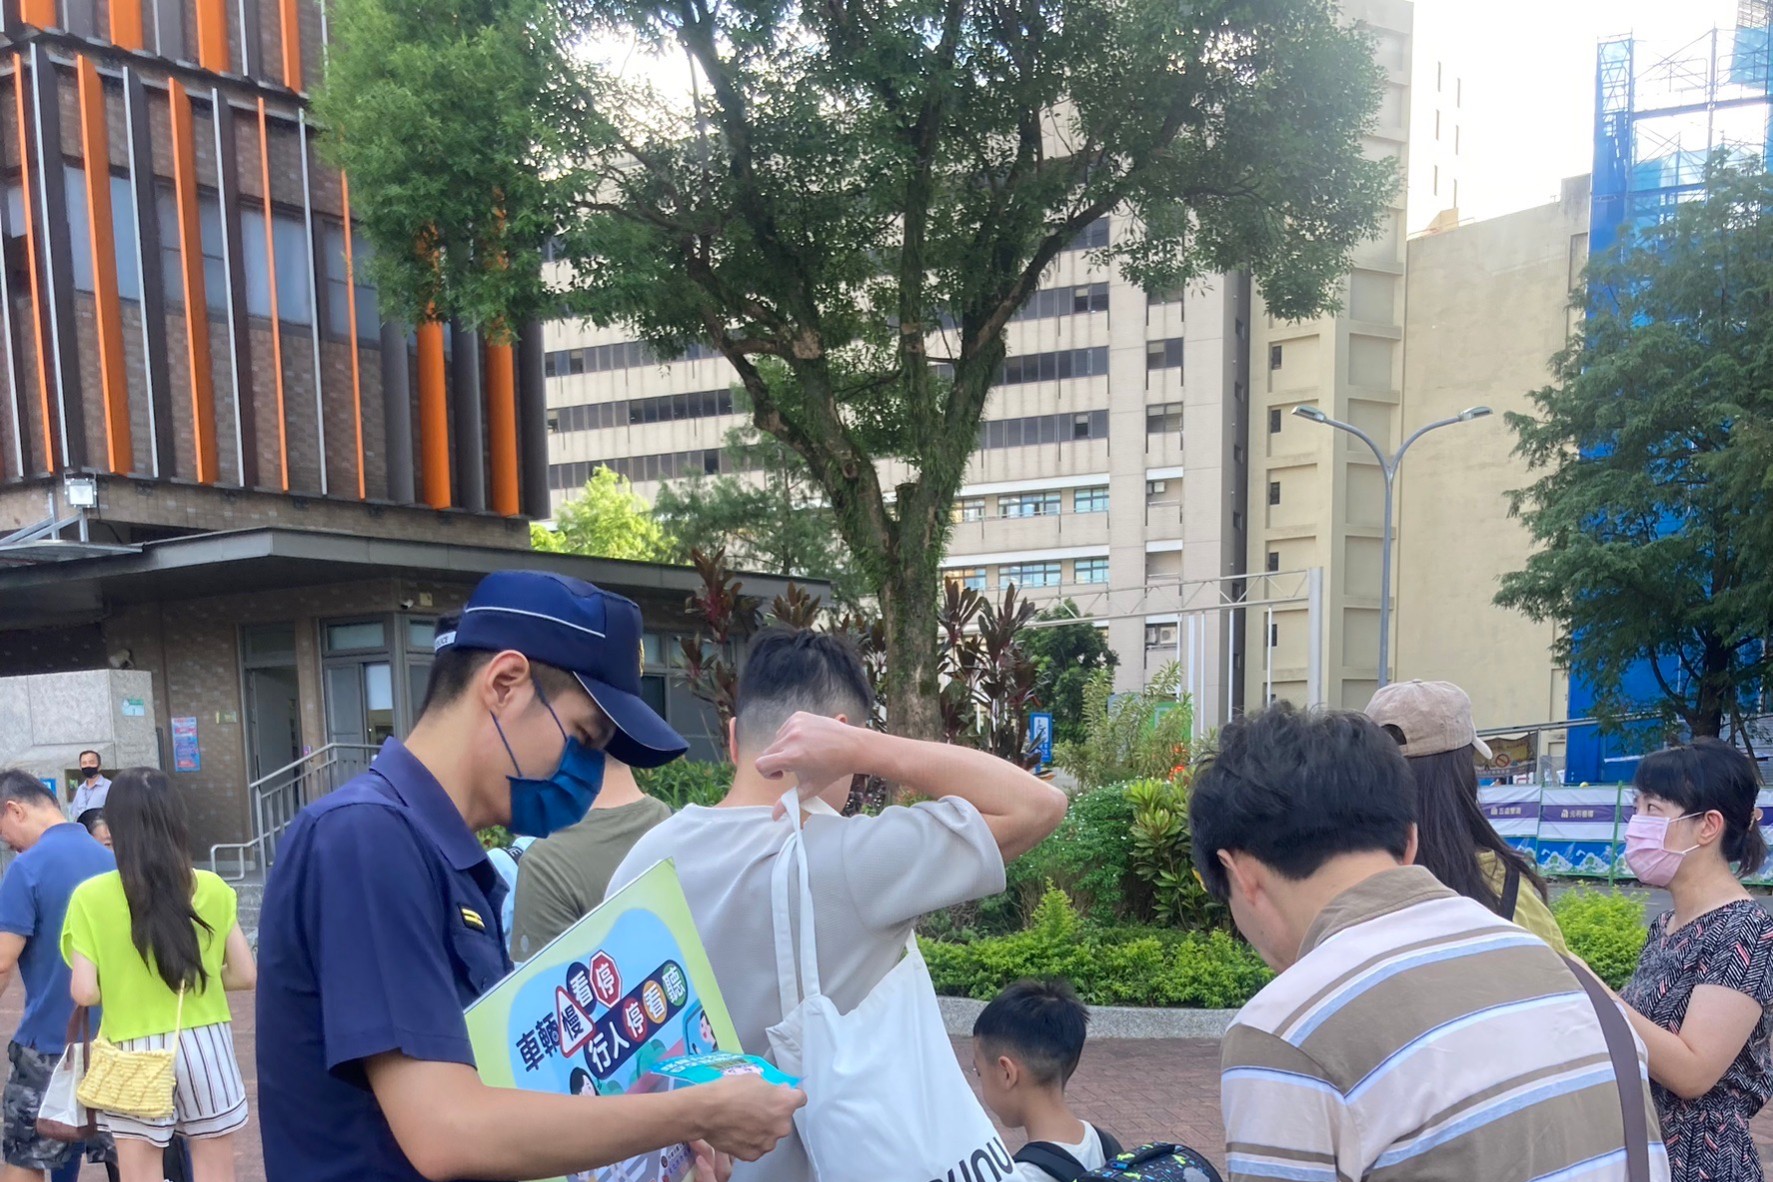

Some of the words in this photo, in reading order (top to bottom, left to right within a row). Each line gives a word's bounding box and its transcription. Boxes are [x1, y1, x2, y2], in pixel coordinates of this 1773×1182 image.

[588, 965, 686, 1073] 行人停看聽
